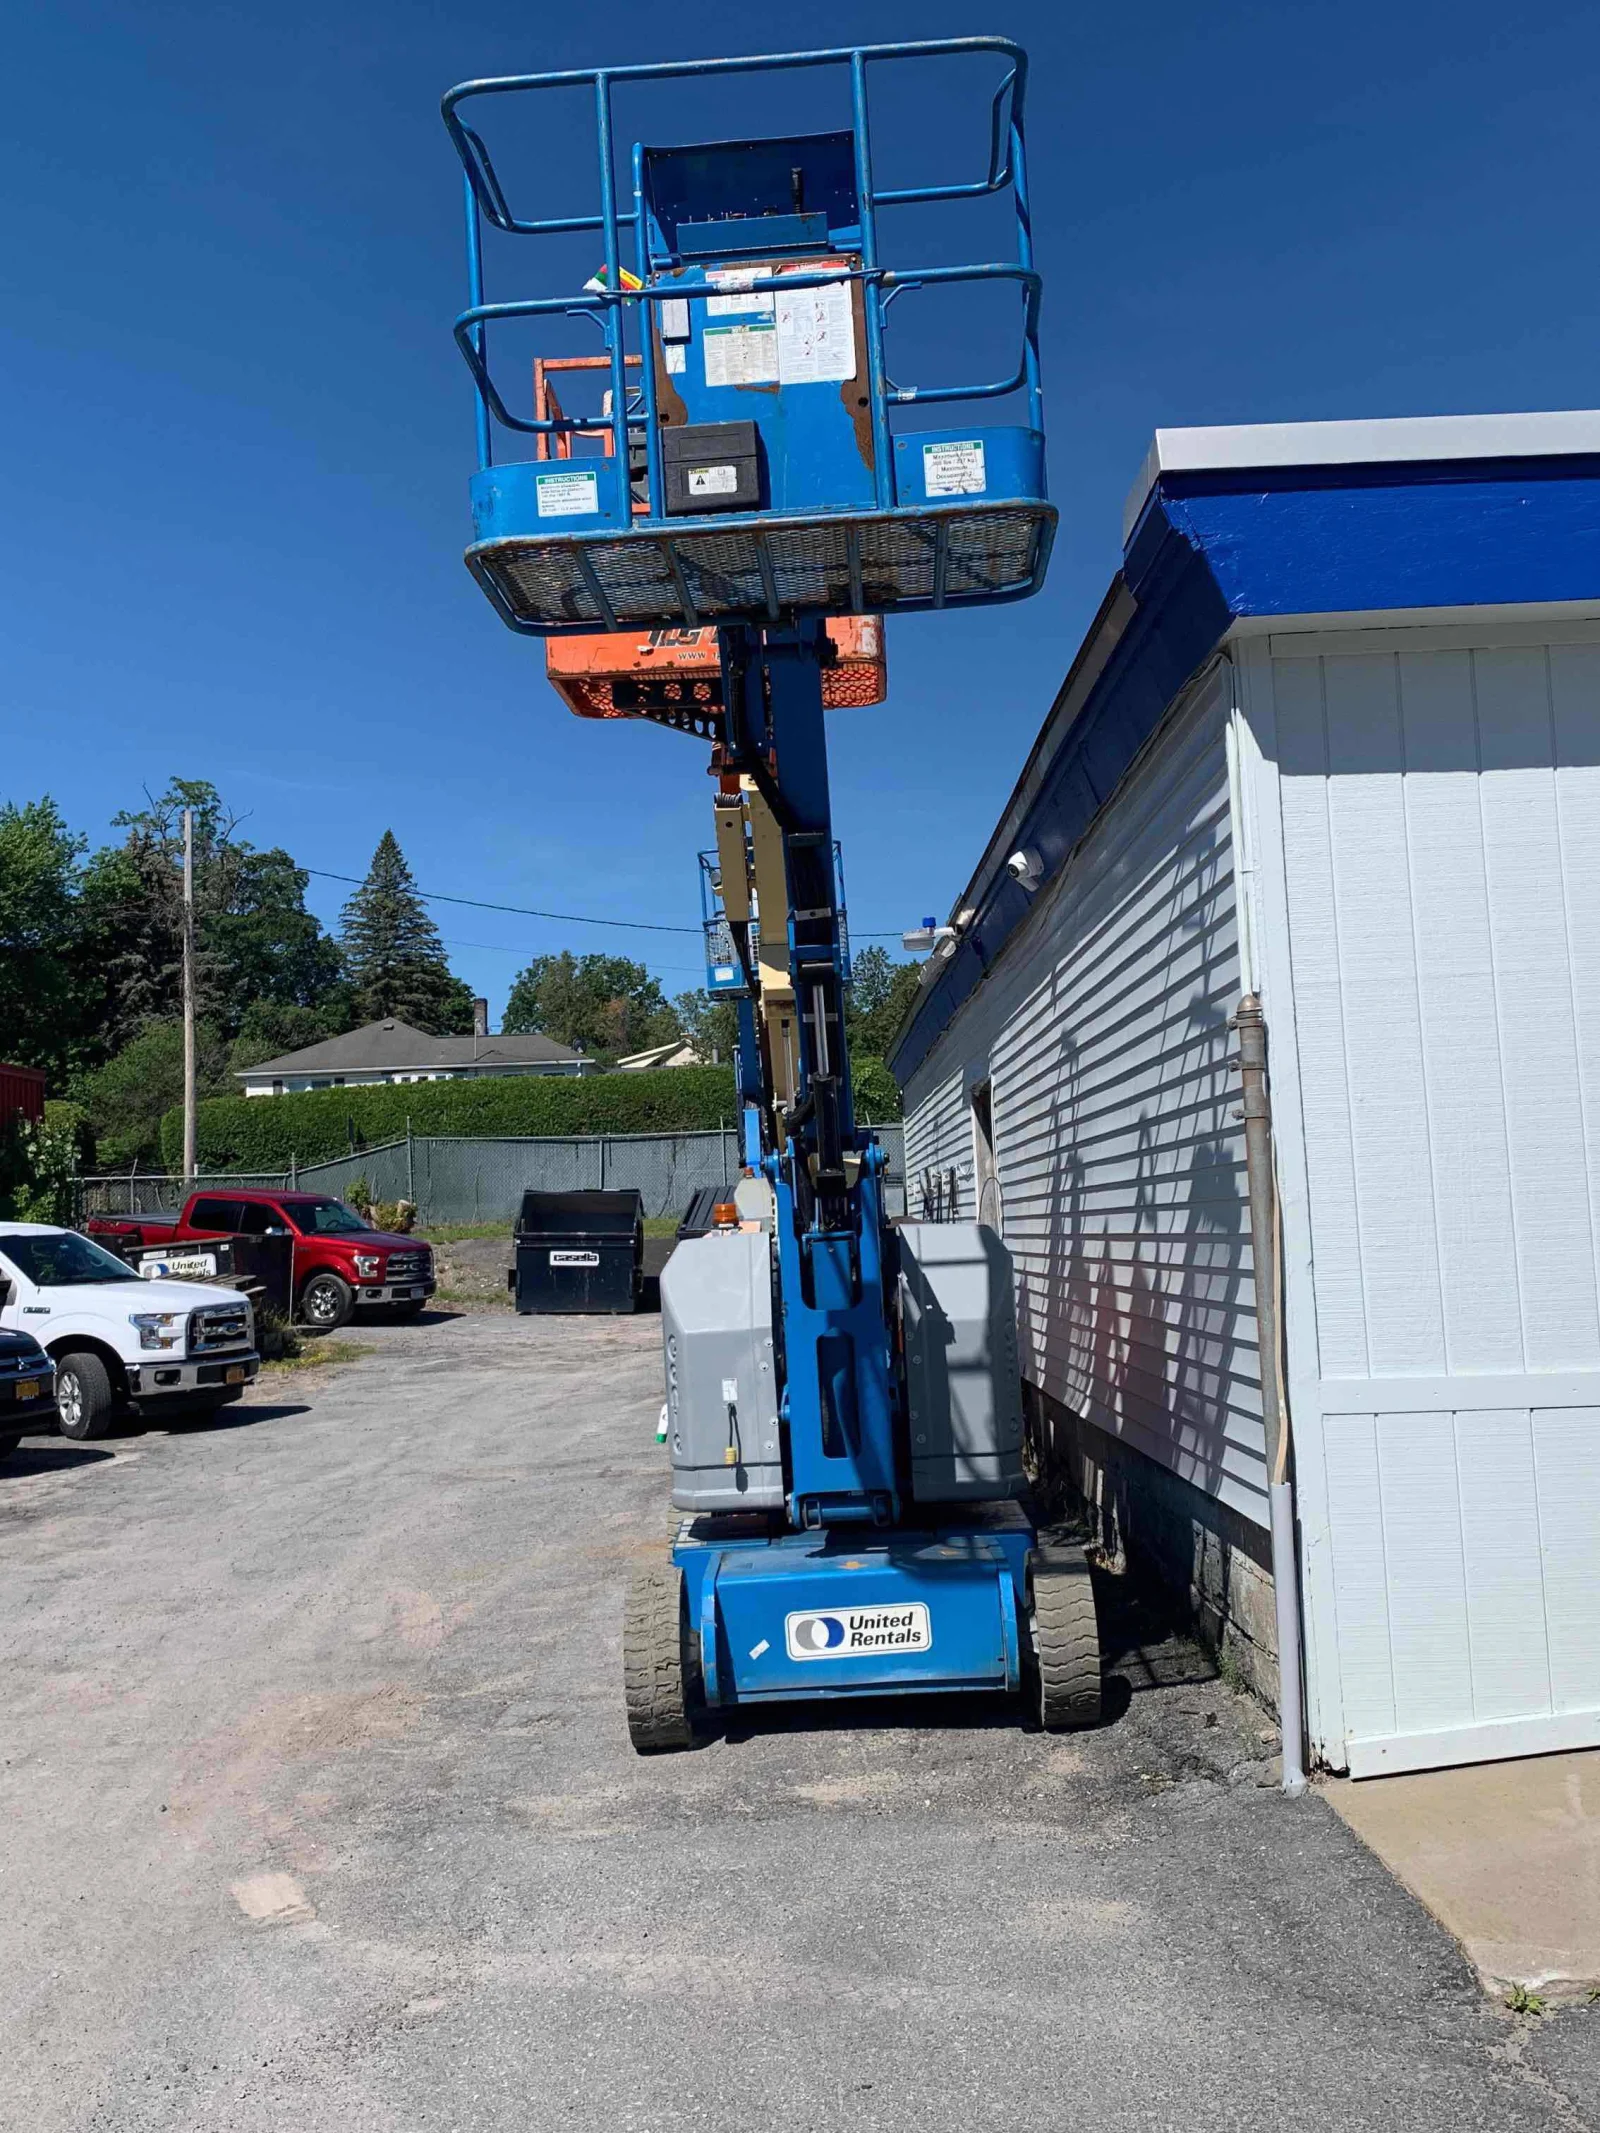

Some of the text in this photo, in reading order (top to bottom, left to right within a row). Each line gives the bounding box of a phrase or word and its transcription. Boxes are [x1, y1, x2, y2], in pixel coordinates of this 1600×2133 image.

[172, 1259, 208, 1271] United
[553, 1253, 598, 1261] casella
[849, 1611, 914, 1631] United
[850, 1628, 922, 1648] Rentals
